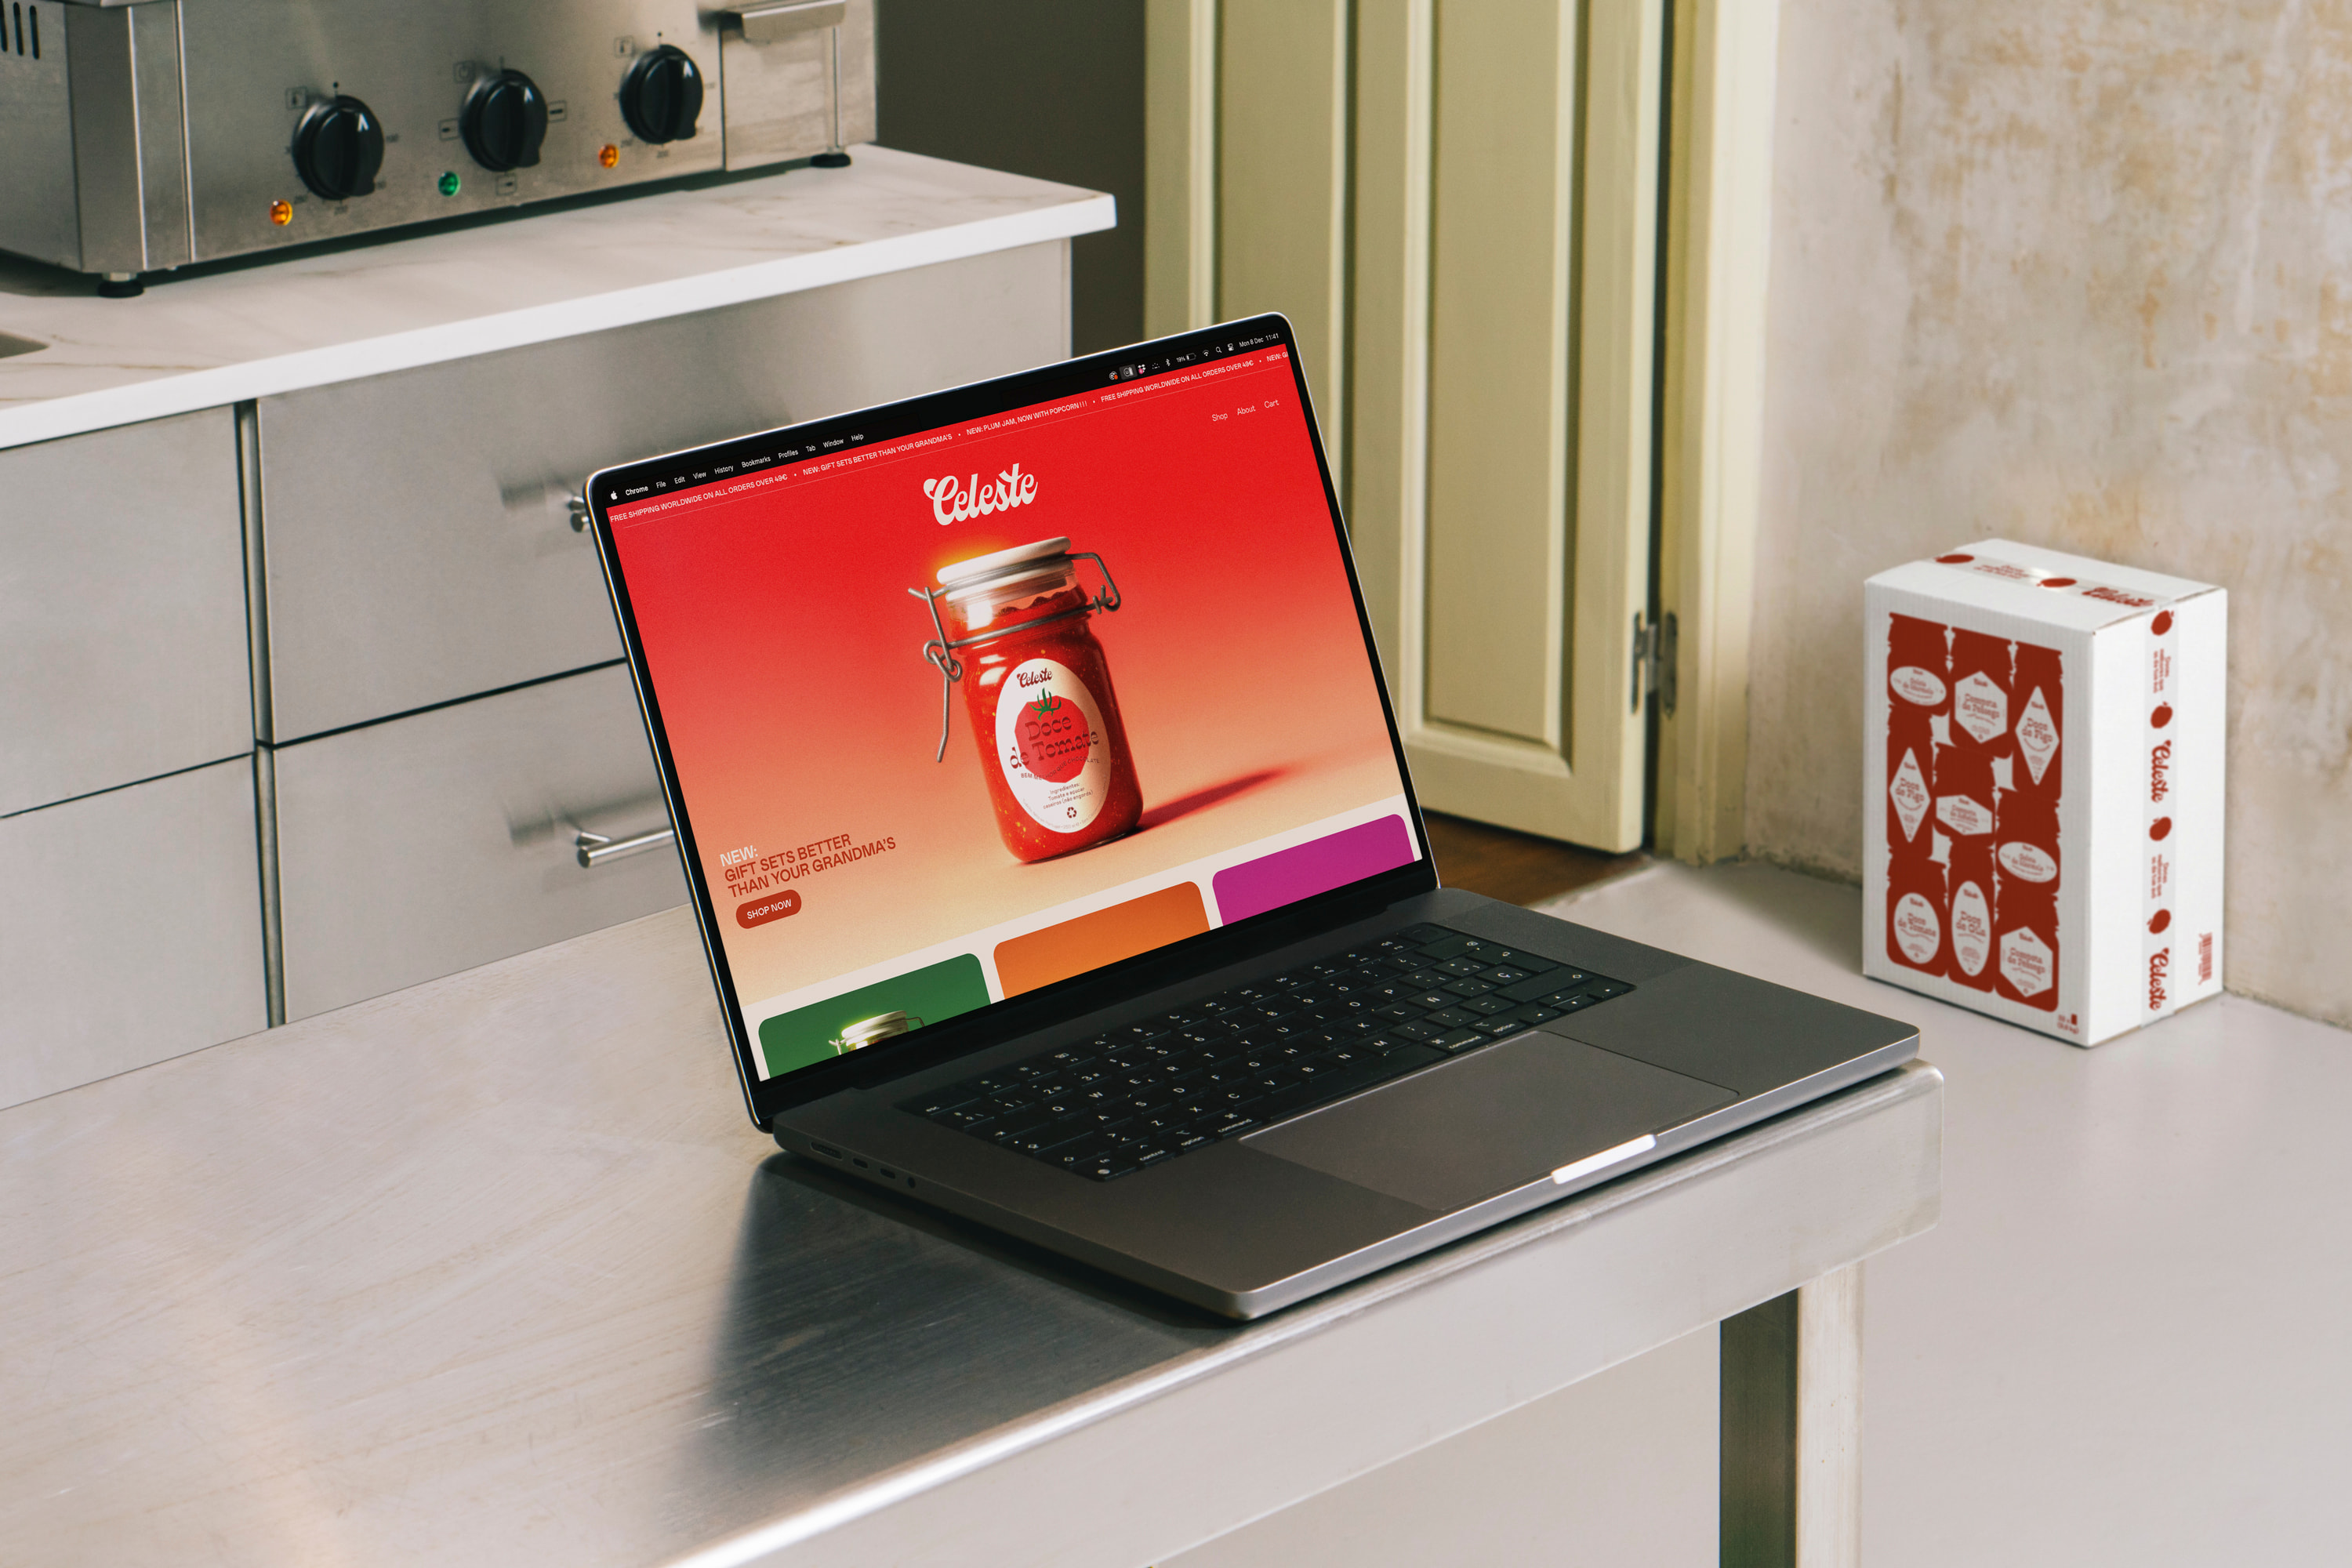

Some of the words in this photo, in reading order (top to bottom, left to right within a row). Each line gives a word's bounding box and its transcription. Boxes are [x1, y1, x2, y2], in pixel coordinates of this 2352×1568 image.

[1265, 332, 1279, 341] 11:41
[1266, 353, 1282, 361] NEW:
[1101, 393, 1116, 402] FREE
[1116, 386, 1146, 398] SHIPPING
[1145, 377, 1181, 391] WORLDWIDE
[1203, 365, 1229, 377] ORDERS
[1227, 361, 1244, 371] OVER
[1237, 405, 1256, 416] About
[1264, 399, 1279, 408] Cart
[966, 426, 983, 435] NEW:
[983, 421, 1001, 431] PLUM
[1001, 418, 1017, 426] JAM,
[1017, 413, 1033, 423] NOW
[1033, 409, 1049, 419] WITH
[1211, 413, 1228, 422] Shop
[625, 486, 648, 495] Chrome
[714, 466, 733, 474] History
[741, 456, 771, 468] Bookmarks
[778, 449, 798, 459] Profiles
[822, 438, 844, 448] Window
[802, 466, 820, 475] NEW:
[820, 462, 835, 470] GIFT
[836, 458, 853, 467] SETS
[852, 452, 877, 463] BETTER
[877, 447, 896, 456] THAN
[896, 442, 914, 452] YOUR
[914, 434, 953, 448] GRANDMA'S
[610, 512, 628, 522] FREE
[628, 505, 660, 517] SHIPPING
[660, 494, 702, 510] WORLDWIDE
[714, 488, 728, 497] ALL
[728, 481, 755, 493] ORDERS
[755, 477, 774, 487] OVER
[923, 463, 1038, 525] Celeste
[1017, 668, 1053, 688] Celeste
[1025, 716, 1072, 741] Doce
[1010, 746, 1029, 769] de
[1031, 731, 1099, 761] Tomate
[1034, 770, 1056, 780] MELHOR
[1056, 760, 1067, 771] QUE
[2151, 739, 2172, 803] Celeste
[720, 845, 758, 867] NEW:
[724, 862, 757, 882] GIFT
[760, 851, 795, 872] SETS
[797, 833, 851, 860] BETTER
[728, 876, 769, 898] THAN
[771, 862, 811, 885] YOUR
[812, 837, 896, 873] GRANDMA'S
[746, 906, 770, 920] SHOP
[771, 898, 792, 913] NOW
[2149, 948, 2169, 1010] Celeste
